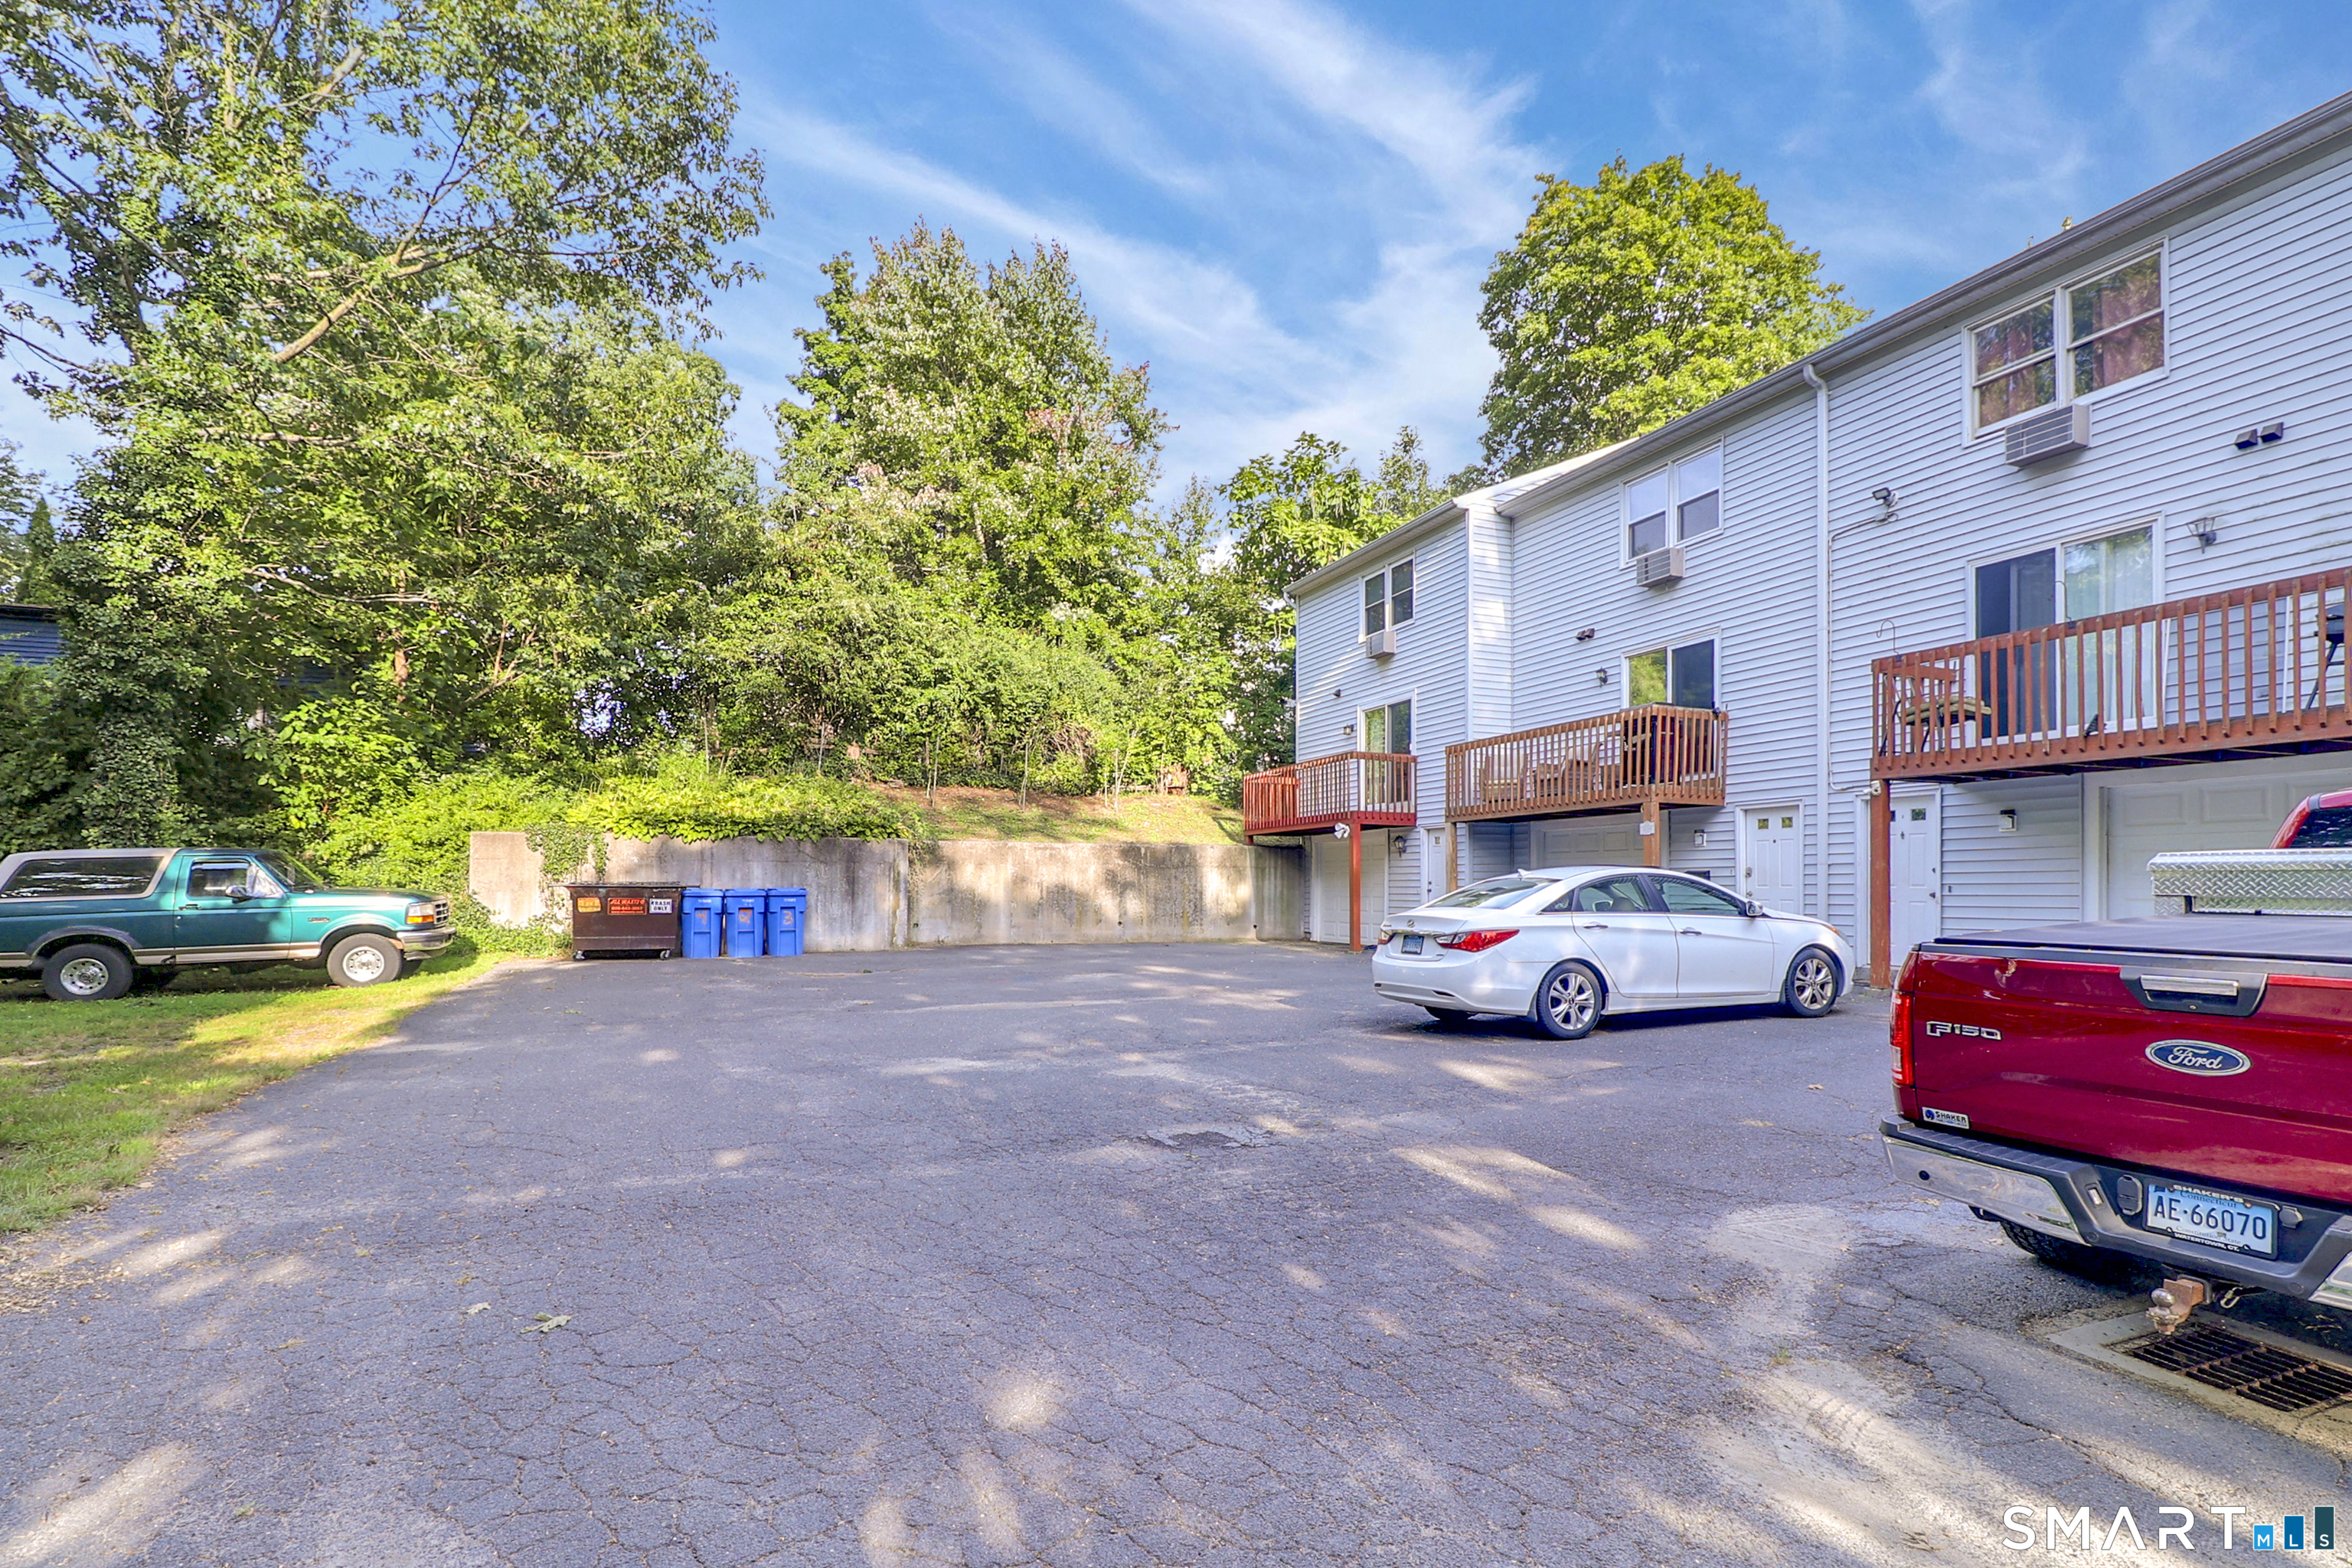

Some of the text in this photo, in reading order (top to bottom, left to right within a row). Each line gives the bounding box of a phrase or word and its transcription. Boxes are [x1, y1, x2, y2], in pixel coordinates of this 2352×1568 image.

[2167, 1047, 2223, 1069] Ford
[1935, 1111, 1967, 1123] SHAKER
[2173, 1184, 2245, 1203] SHAKER'S
[2180, 1191, 2237, 1208] Connecticut
[2176, 1226, 2221, 1240] Constitution
